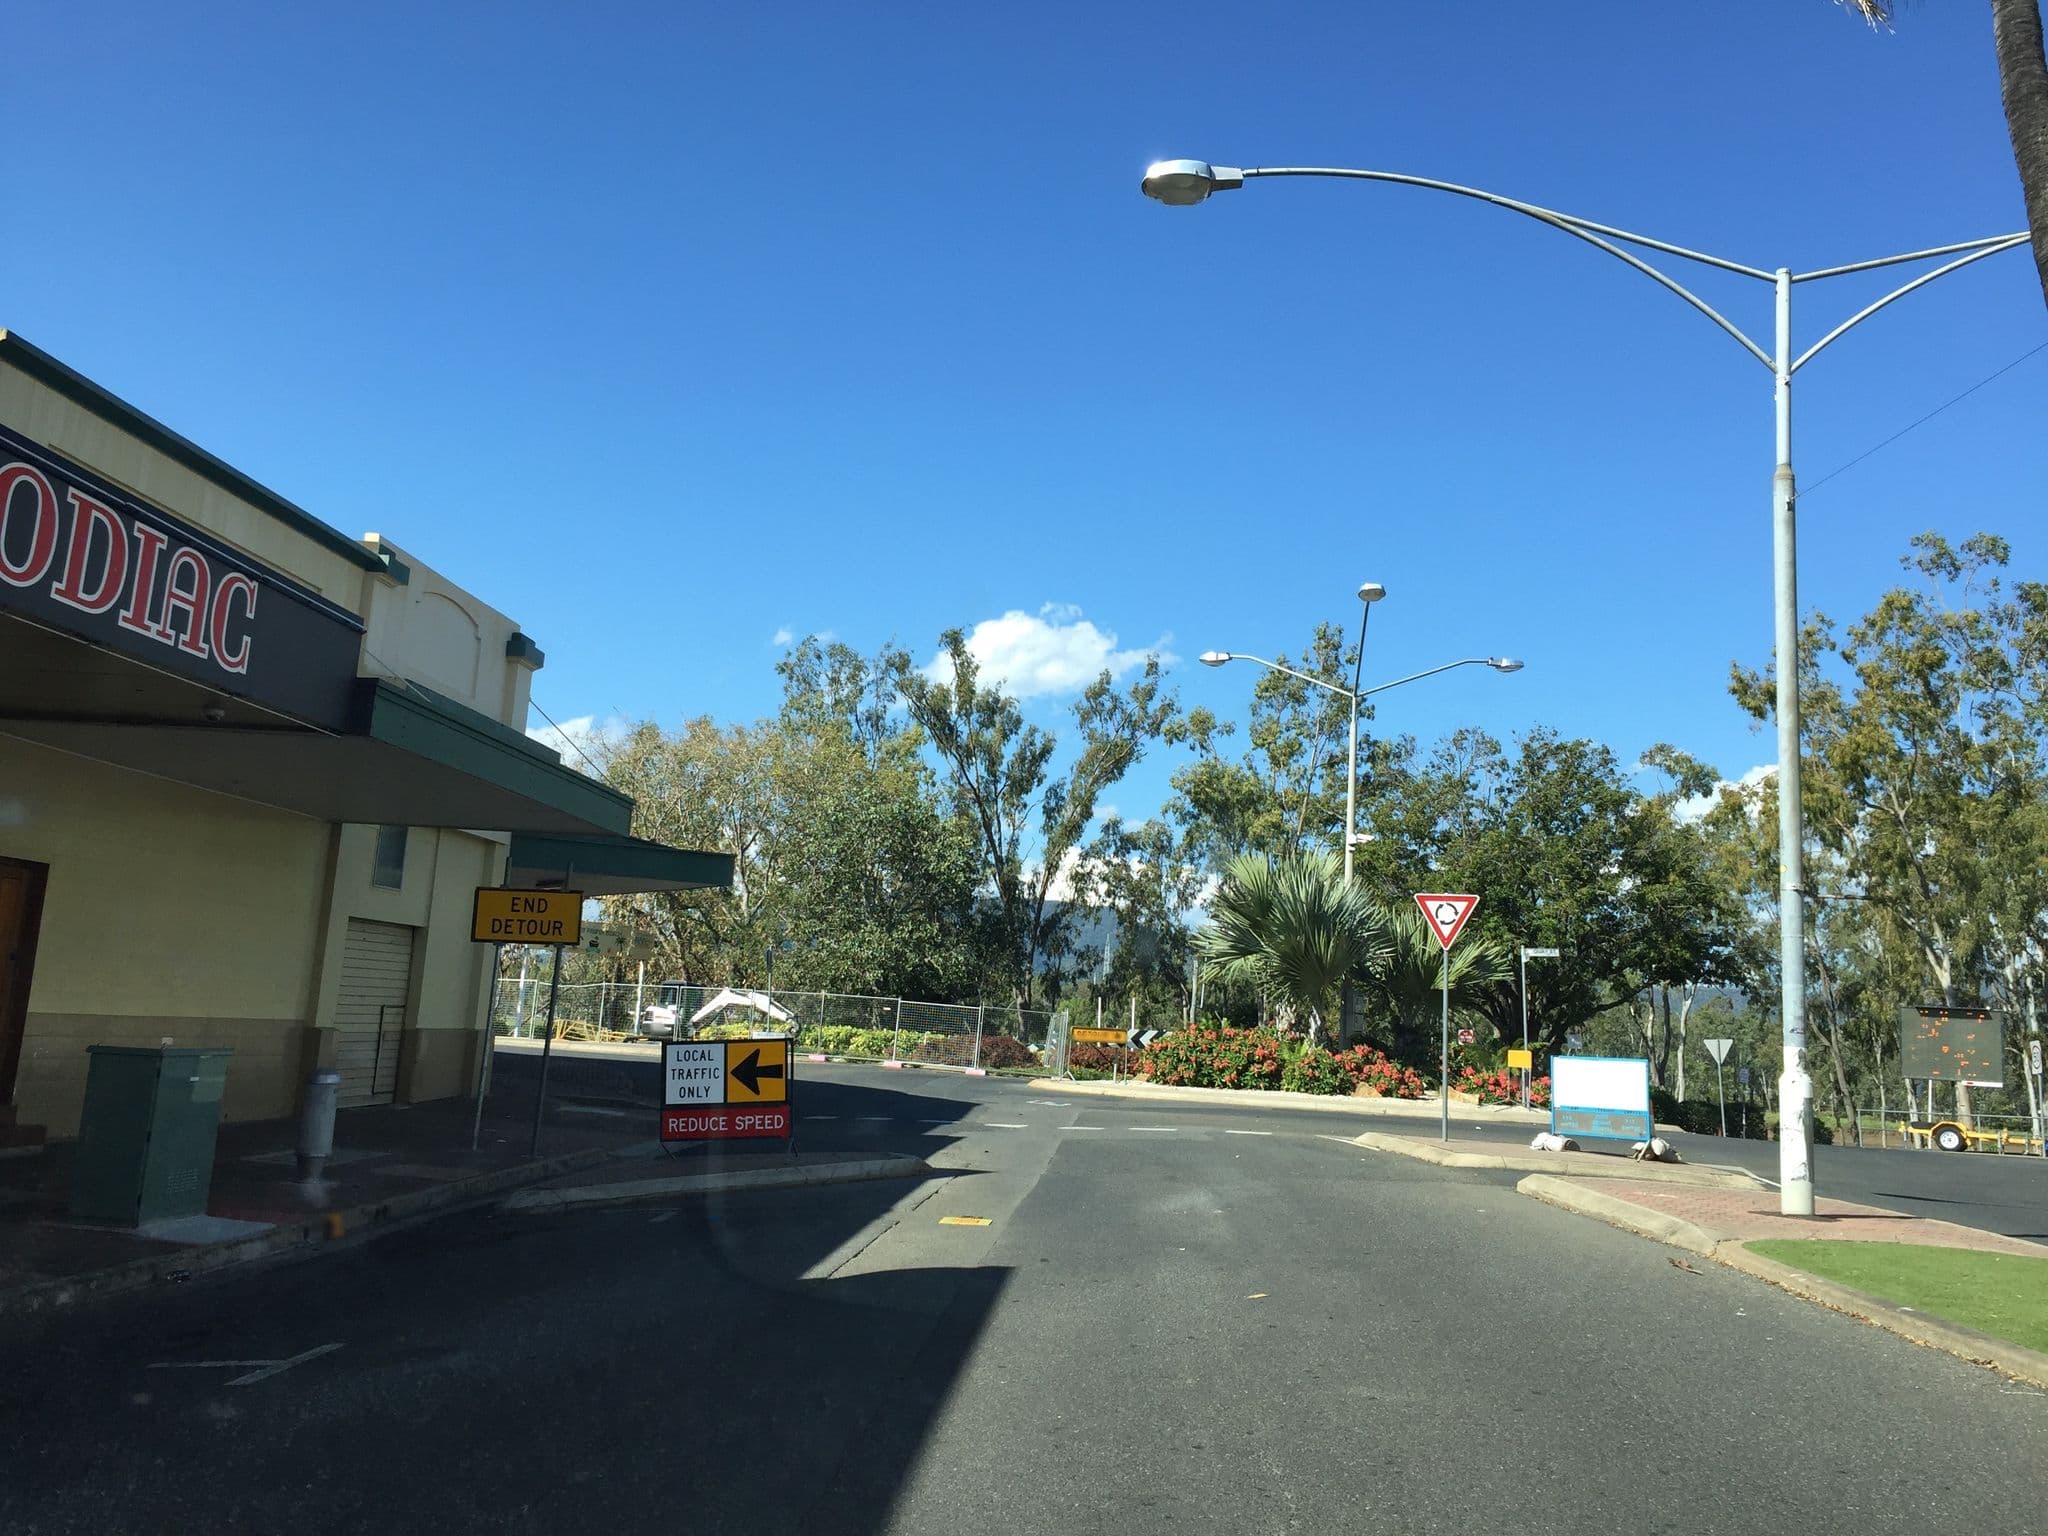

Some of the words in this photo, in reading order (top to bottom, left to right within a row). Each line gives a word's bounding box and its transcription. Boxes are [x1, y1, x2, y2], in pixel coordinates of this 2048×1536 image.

[0, 462, 258, 675] ODIAC
[511, 896, 548, 913] END
[491, 918, 563, 936] DETOUR
[676, 1049, 714, 1062] LOCAL
[671, 1067, 720, 1080] TRAFFIC
[679, 1086, 711, 1098] ONLY
[669, 1116, 728, 1133] REDUCE
[735, 1115, 784, 1130] SPEED
